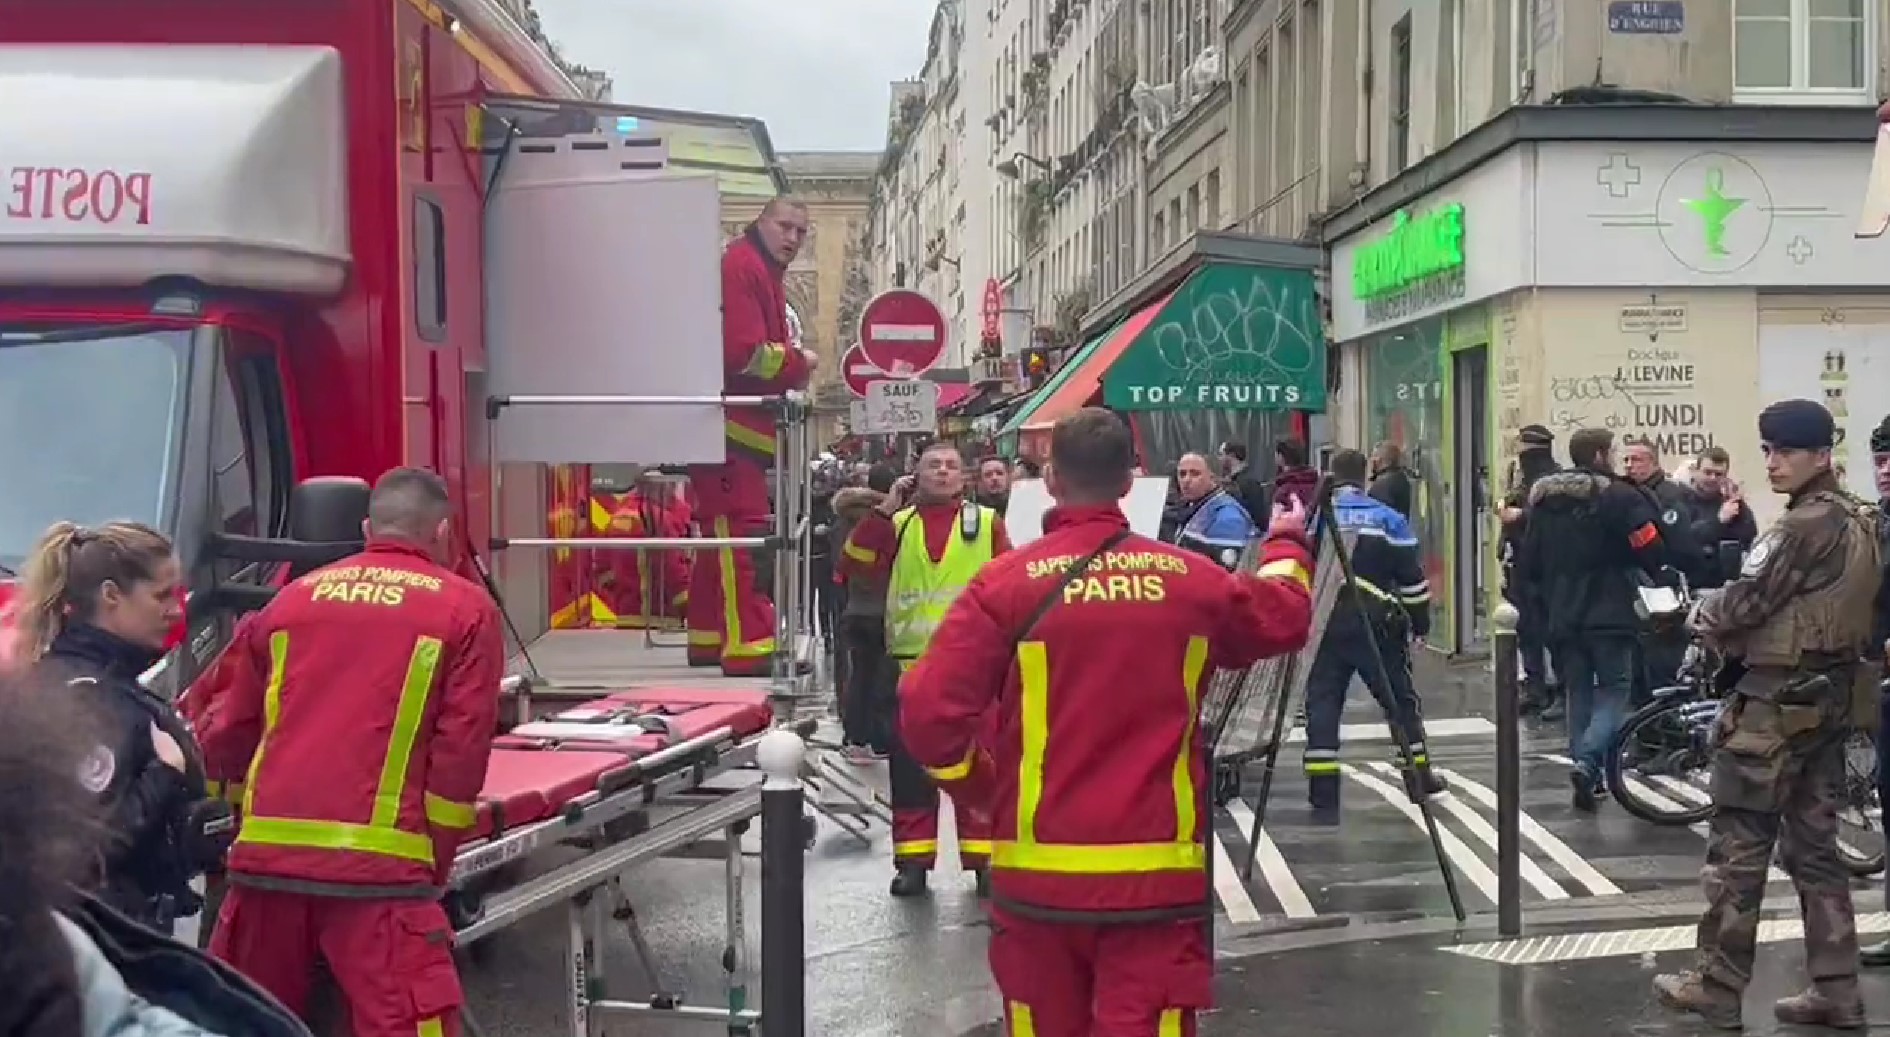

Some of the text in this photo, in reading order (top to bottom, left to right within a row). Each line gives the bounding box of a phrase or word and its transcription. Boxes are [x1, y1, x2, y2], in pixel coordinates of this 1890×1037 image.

[1614, 365, 1694, 382] J. LEVINE
[882, 383, 920, 397] SAUF
[1128, 385, 1300, 402] TOP FRUITS
[1605, 404, 1703, 428] du LUNDI
[1026, 552, 1188, 579] SAPES POMPIERS
[363, 566, 442, 592] POMPIERS
[1063, 575, 1166, 604] PARIS
[311, 582, 405, 606] PARIS
